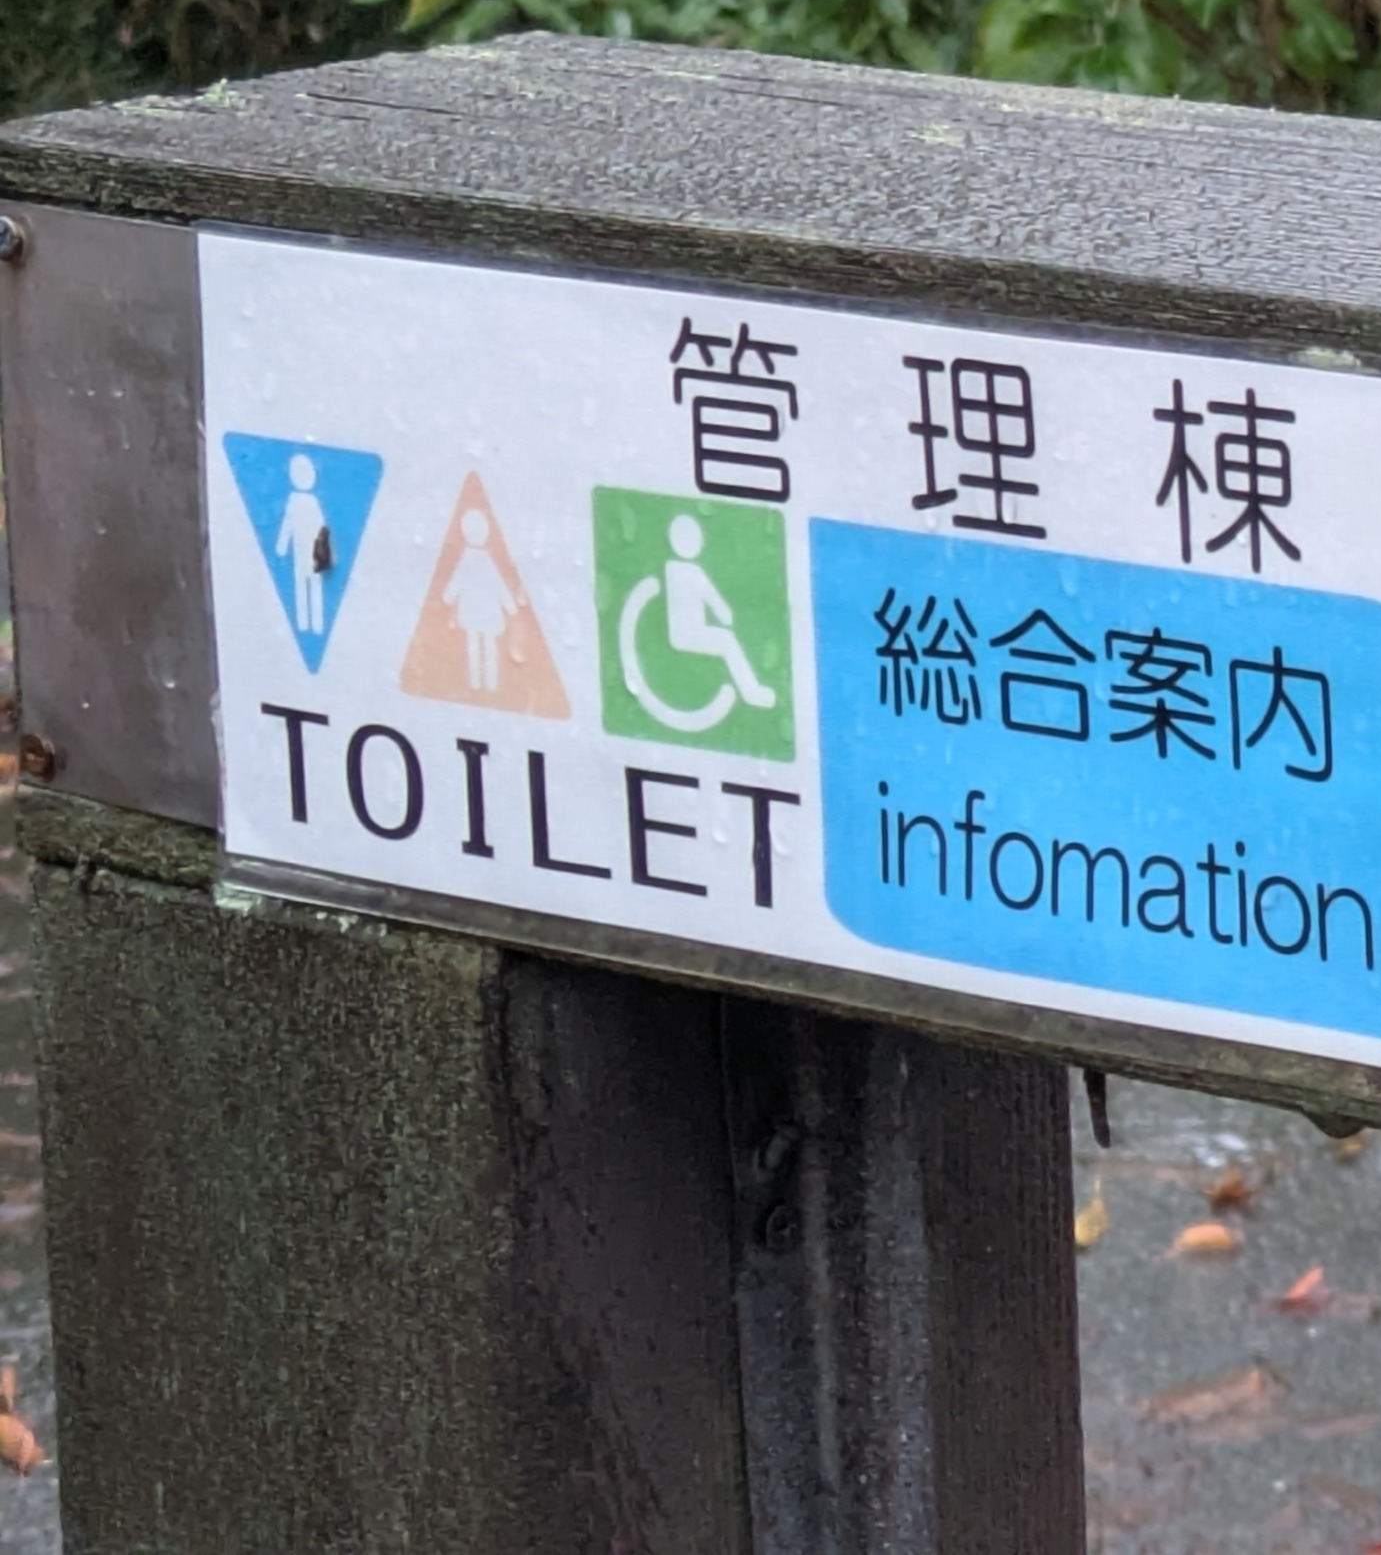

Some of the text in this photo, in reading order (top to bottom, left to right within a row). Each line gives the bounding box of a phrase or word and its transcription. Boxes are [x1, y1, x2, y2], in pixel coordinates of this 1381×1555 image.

[872, 586, 1335, 783] 総合案内
[260, 702, 800, 910] TOILET
[877, 780, 1375, 971] infomation
